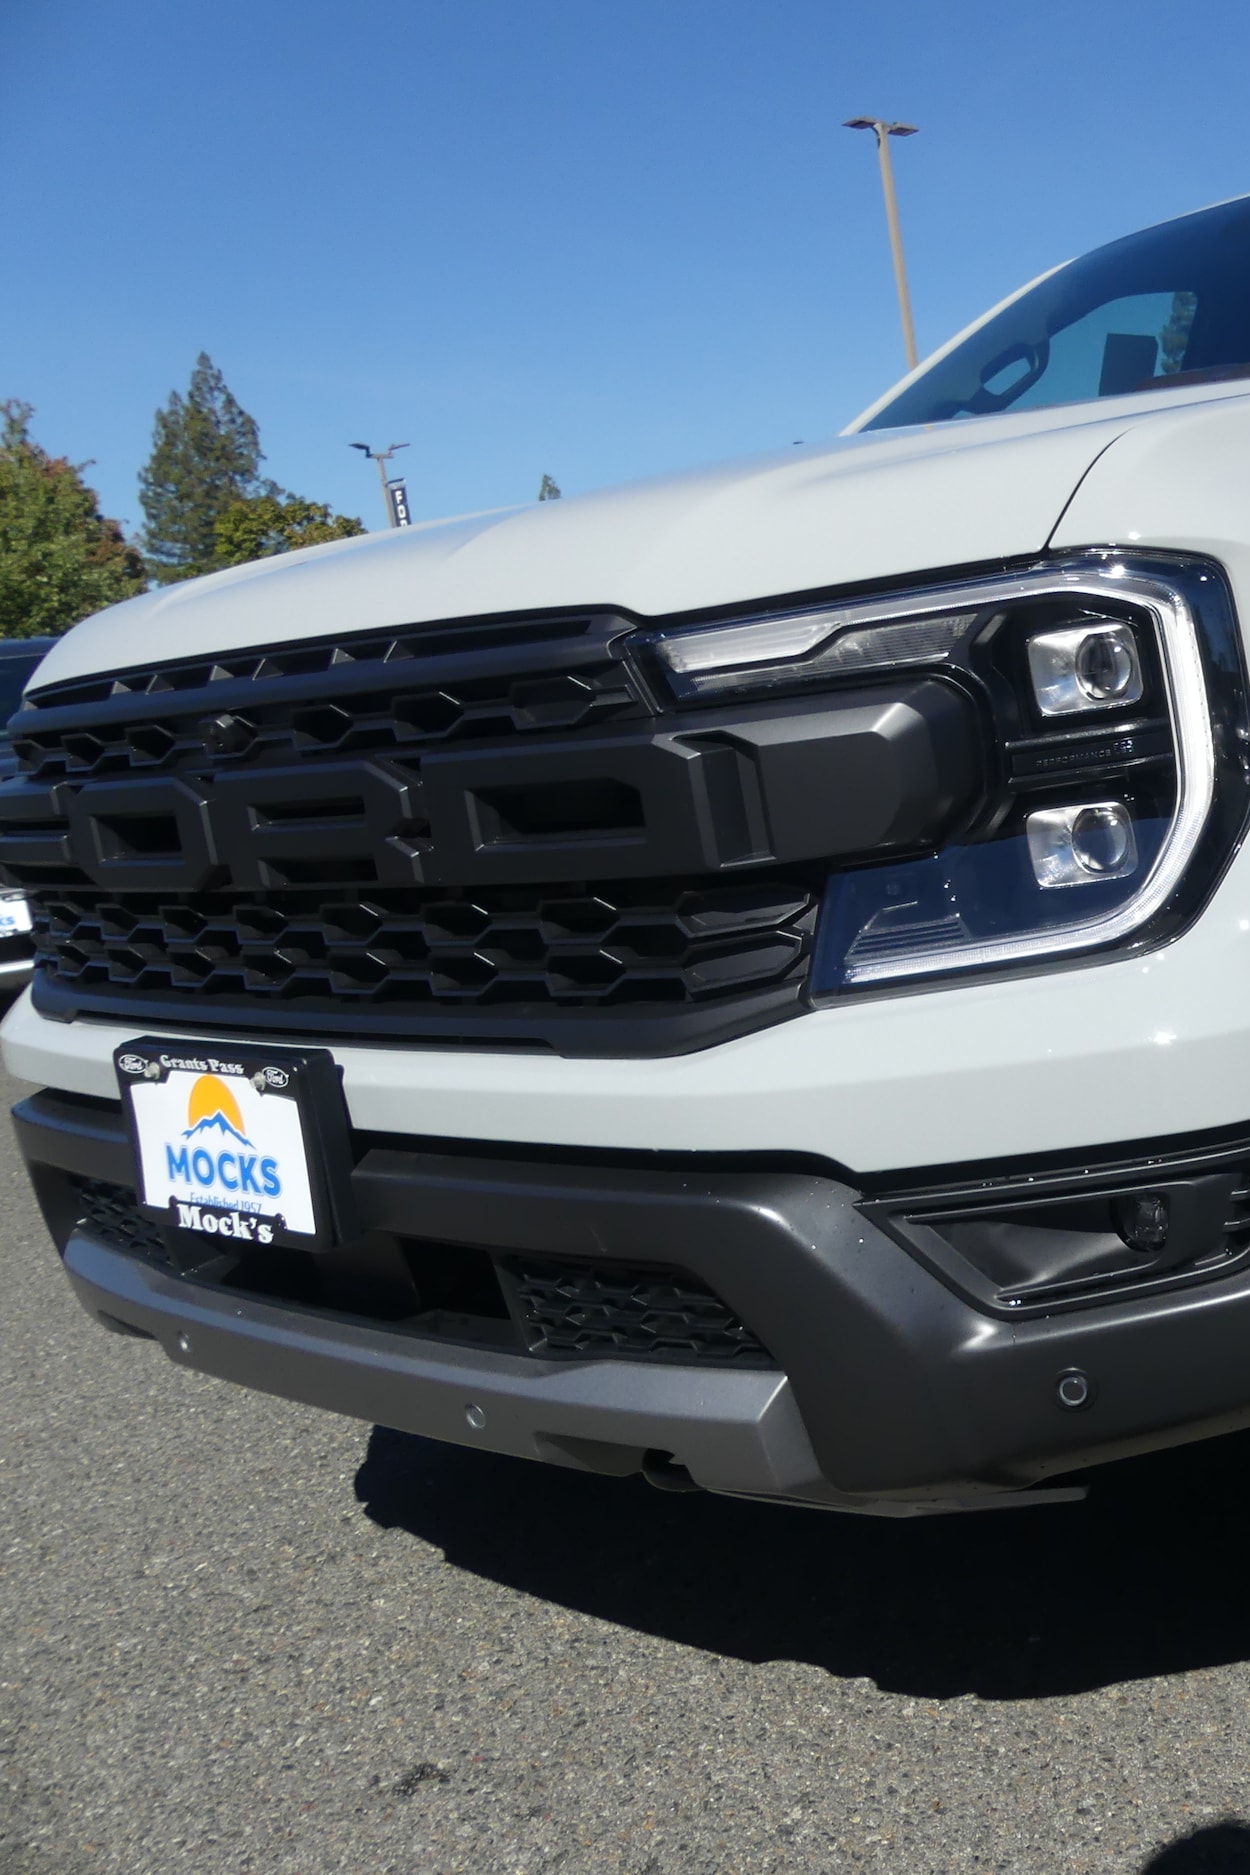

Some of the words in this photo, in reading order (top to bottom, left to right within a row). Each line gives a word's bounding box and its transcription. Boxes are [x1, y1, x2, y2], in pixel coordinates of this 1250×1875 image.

[159, 1054, 207, 1071] Grants
[207, 1059, 245, 1075] Pass
[165, 1144, 282, 1198] MOCKS
[176, 1203, 275, 1244] Mock's
